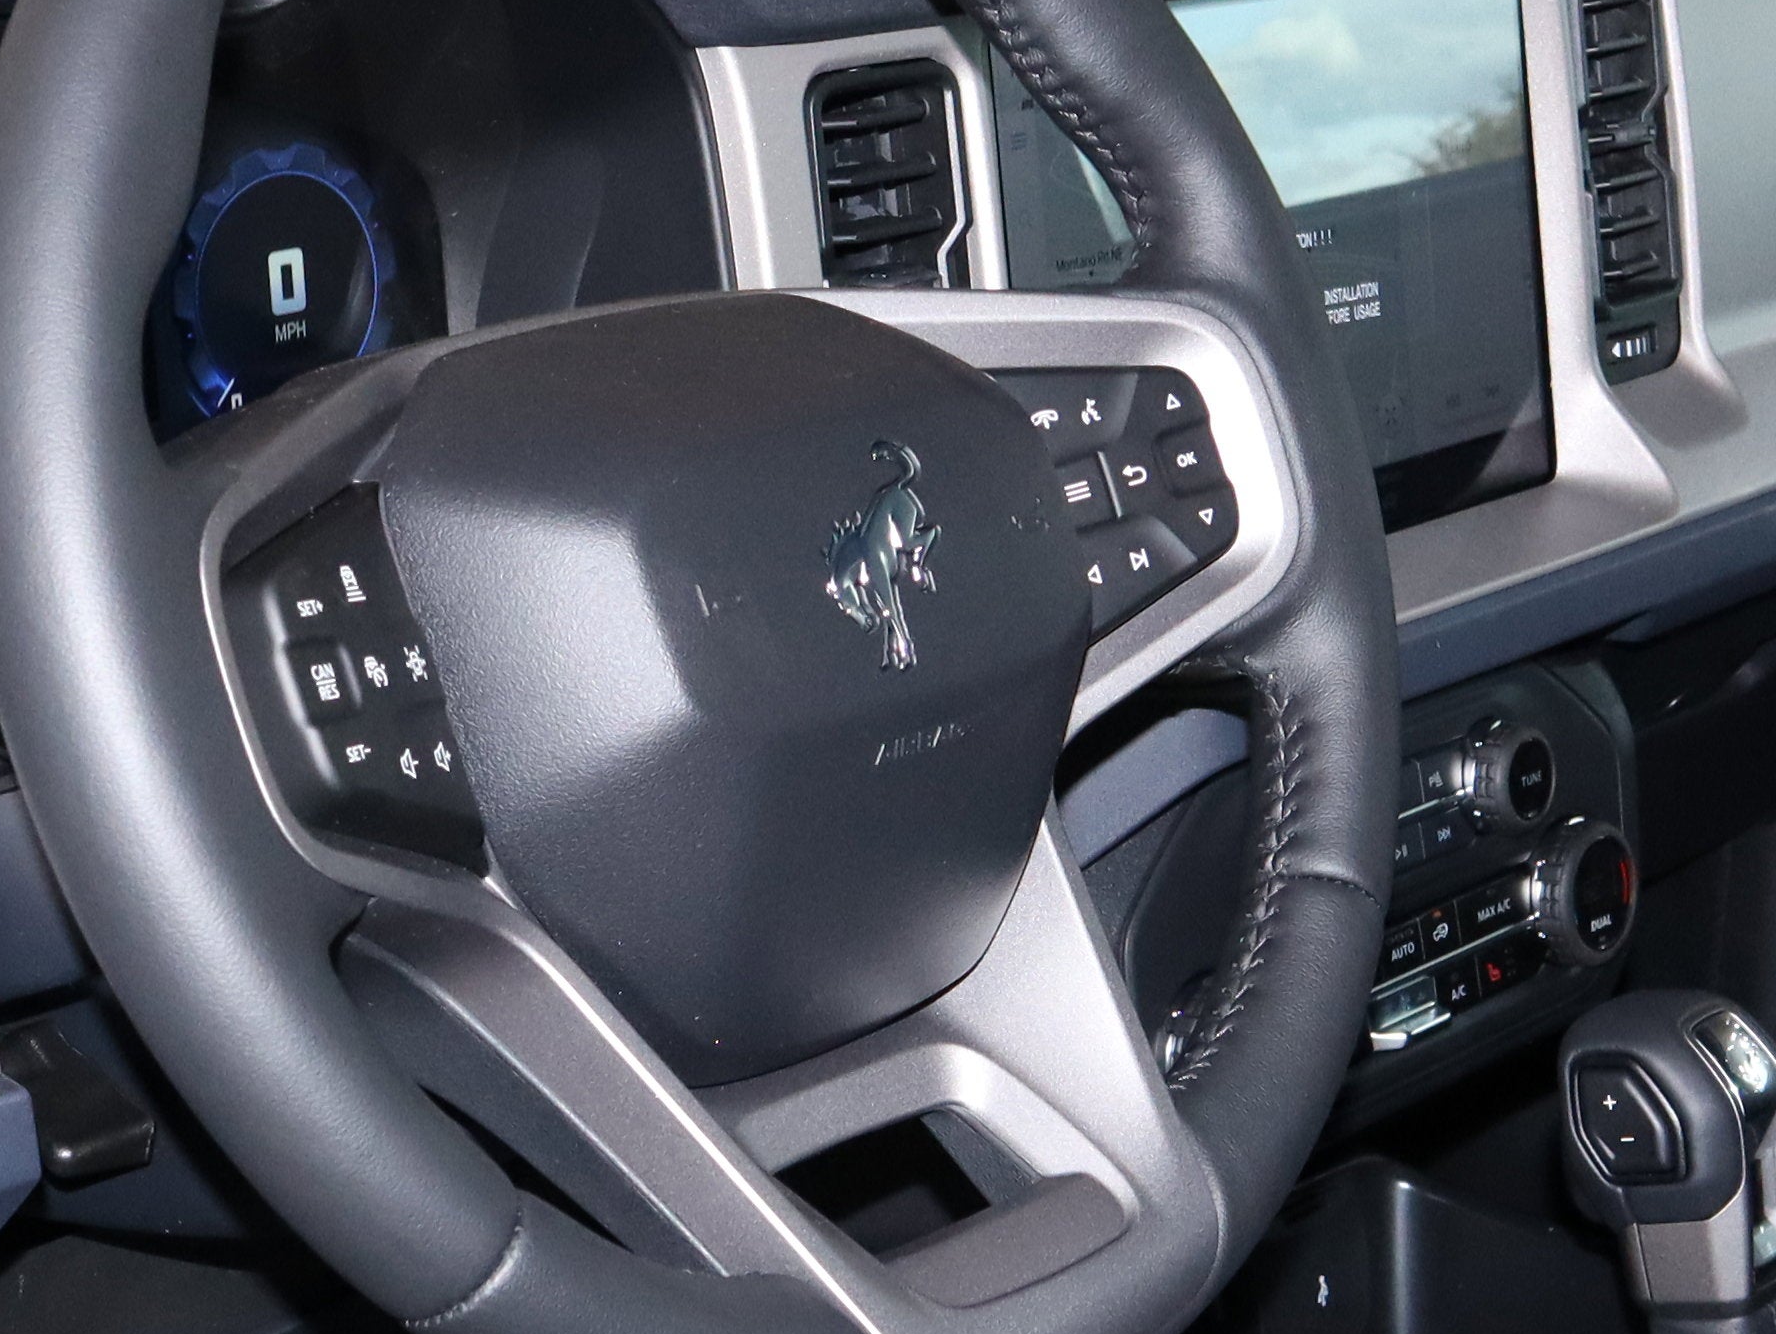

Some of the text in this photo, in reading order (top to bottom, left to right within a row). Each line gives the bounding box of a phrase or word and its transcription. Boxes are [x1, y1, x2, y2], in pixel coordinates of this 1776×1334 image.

[267, 247, 307, 317] 0
[1353, 301, 1381, 321] USAGE
[275, 320, 307, 344] MPH
[1176, 451, 1198, 468] OK
[310, 662, 336, 681] CAN
[1521, 770, 1543, 788] TUNE
[1477, 897, 1511, 923] MAX A/C
[1590, 914, 1612, 933] DUAL
[1391, 941, 1415, 962] AUTO
[1451, 984, 1466, 1001] A/C
